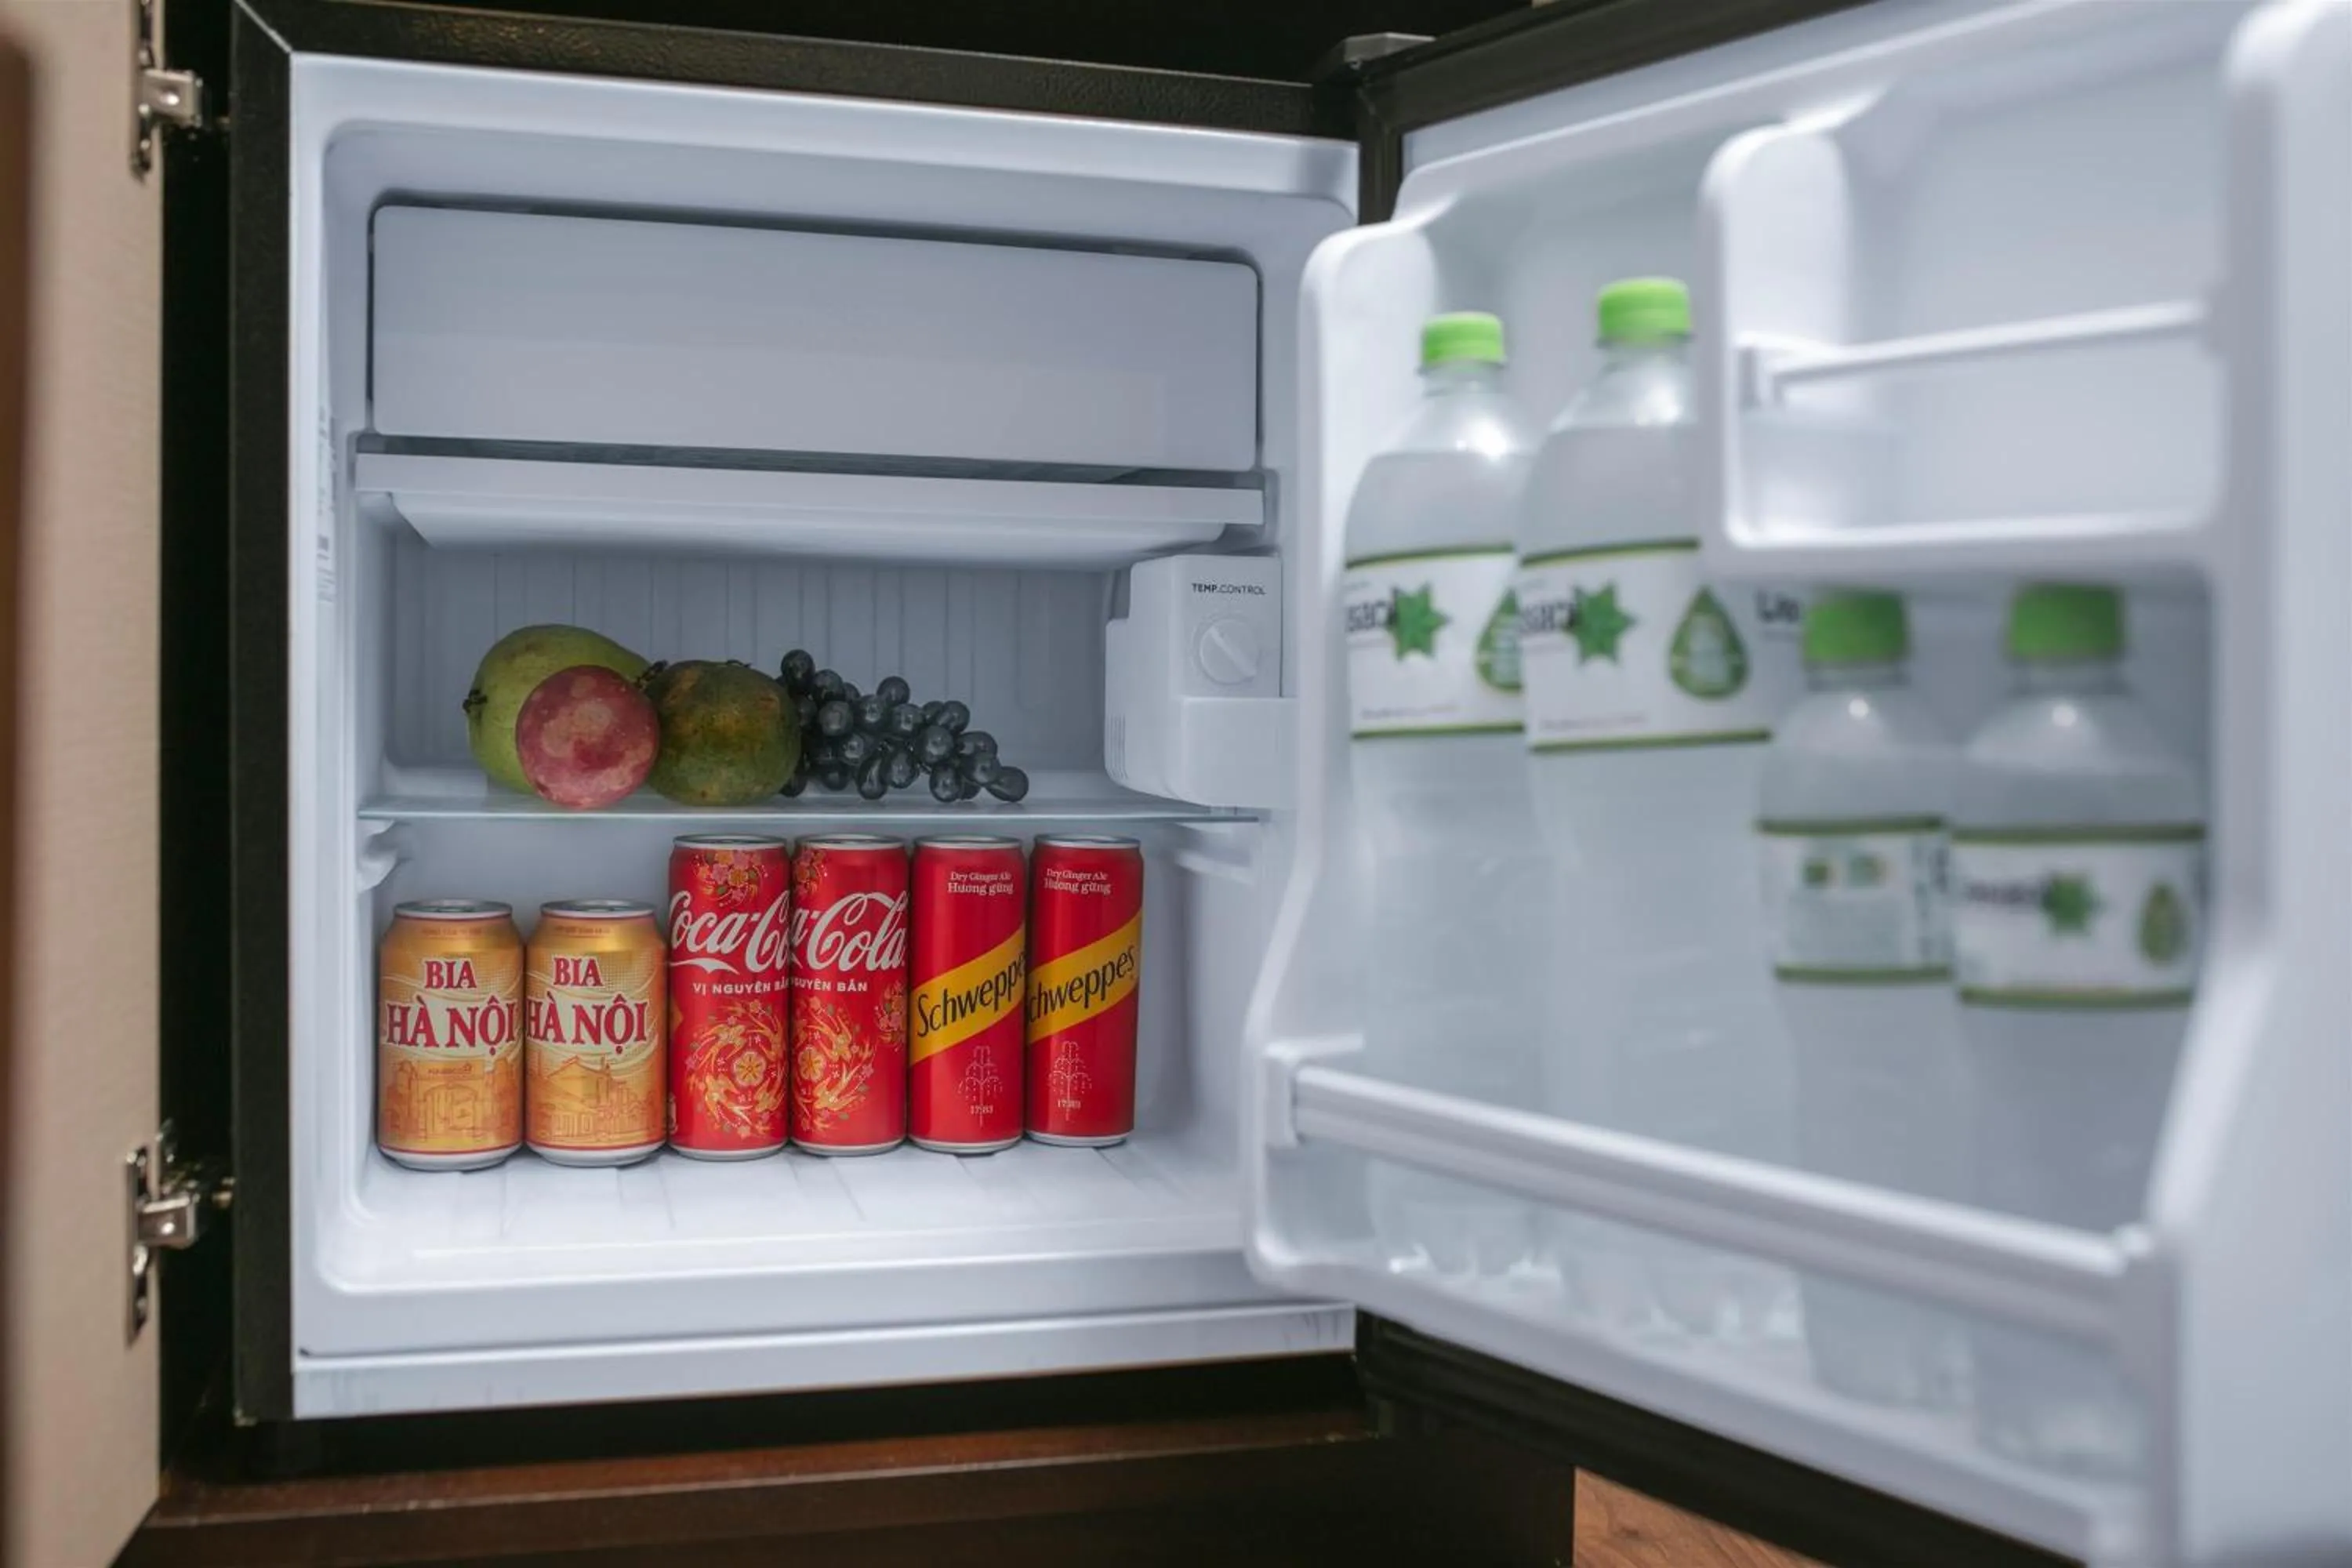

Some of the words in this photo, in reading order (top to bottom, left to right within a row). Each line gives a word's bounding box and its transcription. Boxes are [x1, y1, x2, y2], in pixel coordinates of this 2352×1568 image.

[424, 960, 477, 989] BIA
[553, 957, 603, 986] BIA
[837, 978, 868, 993] BẢN
[712, 981, 771, 994] NGUYÊN
[387, 995, 439, 1048] HÀ
[445, 996, 516, 1055] NỘI
[526, 991, 566, 1044] HÀ
[572, 993, 648, 1054] NỘI
